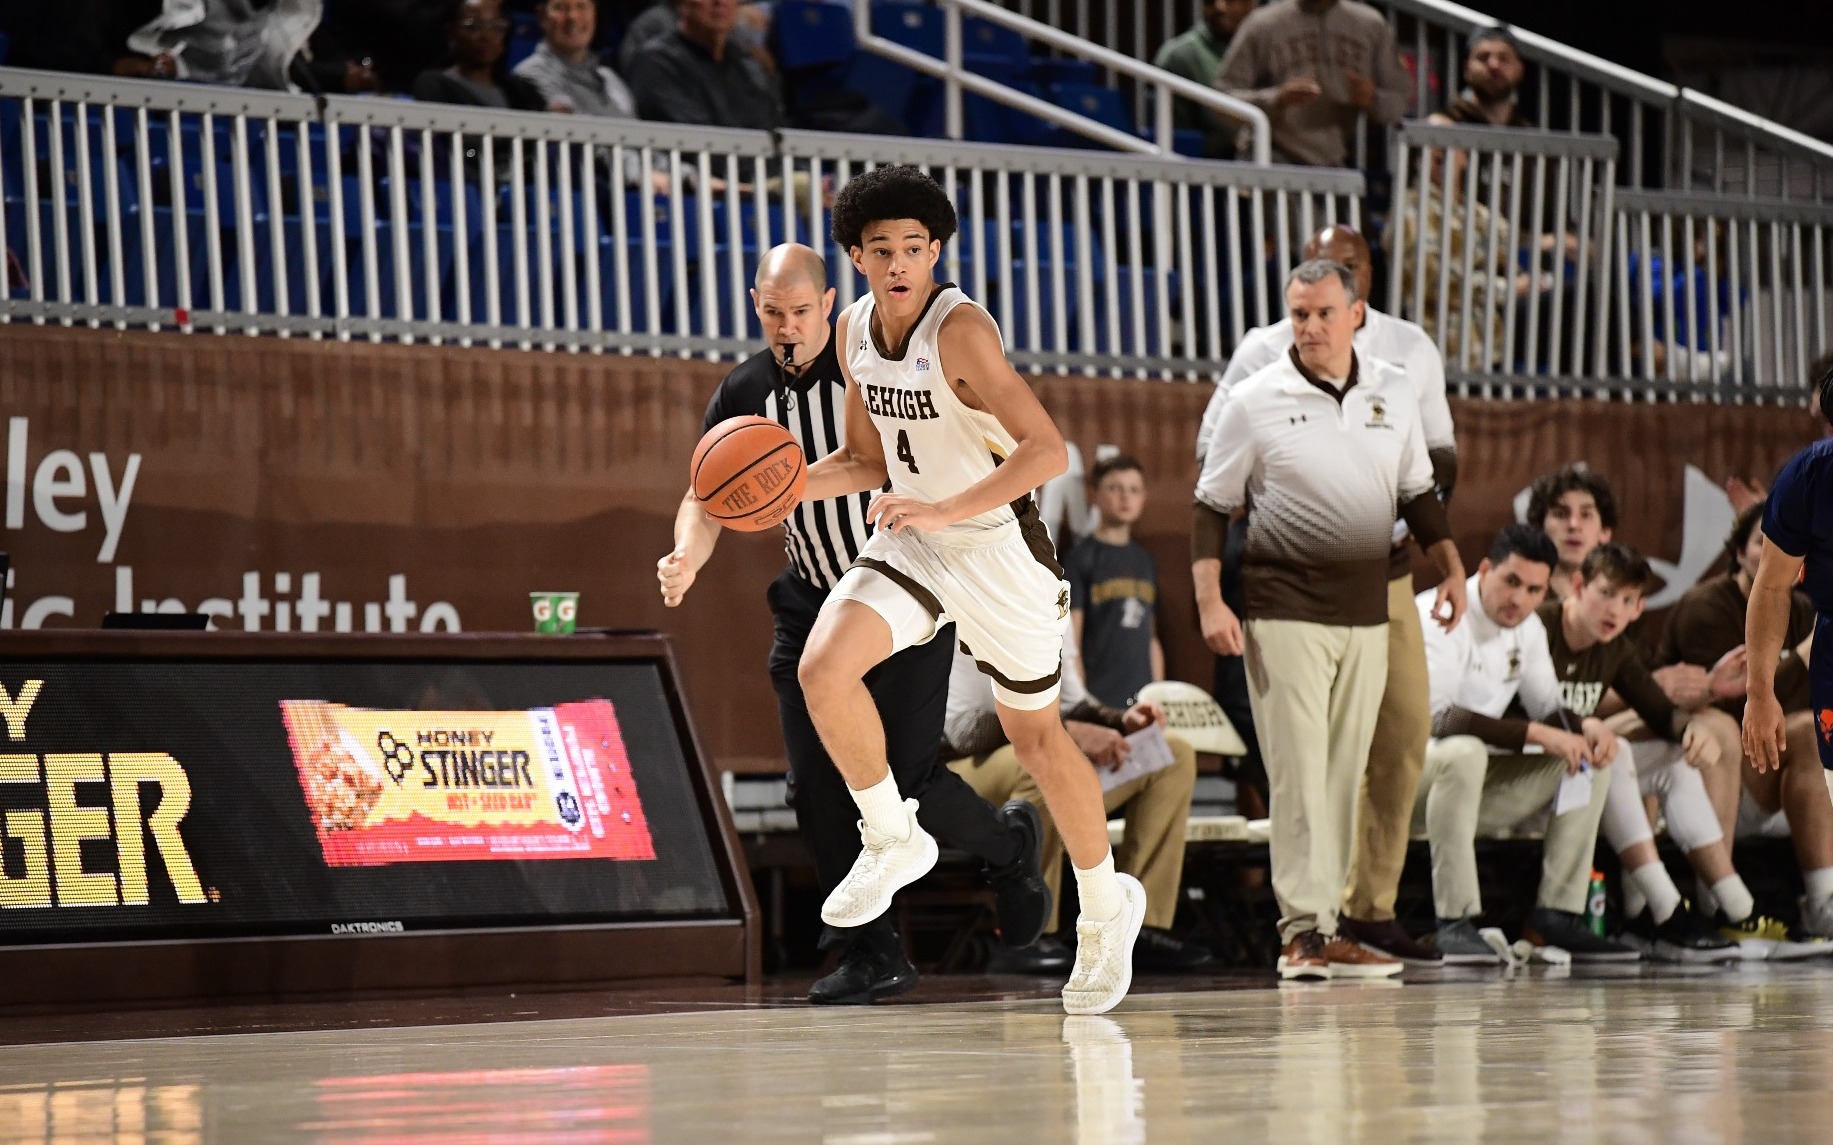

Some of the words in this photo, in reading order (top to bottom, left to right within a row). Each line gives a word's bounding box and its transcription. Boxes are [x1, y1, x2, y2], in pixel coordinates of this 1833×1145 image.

[896, 429, 920, 475] 4
[5, 416, 142, 563] ley
[721, 483, 758, 513] THE
[752, 457, 794, 496] ROCK
[115, 565, 462, 633] Istitut
[0, 679, 45, 742] Y
[416, 730, 495, 748] HONEY
[419, 750, 535, 790] STINGER
[0, 752, 209, 909] GER
[330, 920, 405, 935] DAKTRONICS
